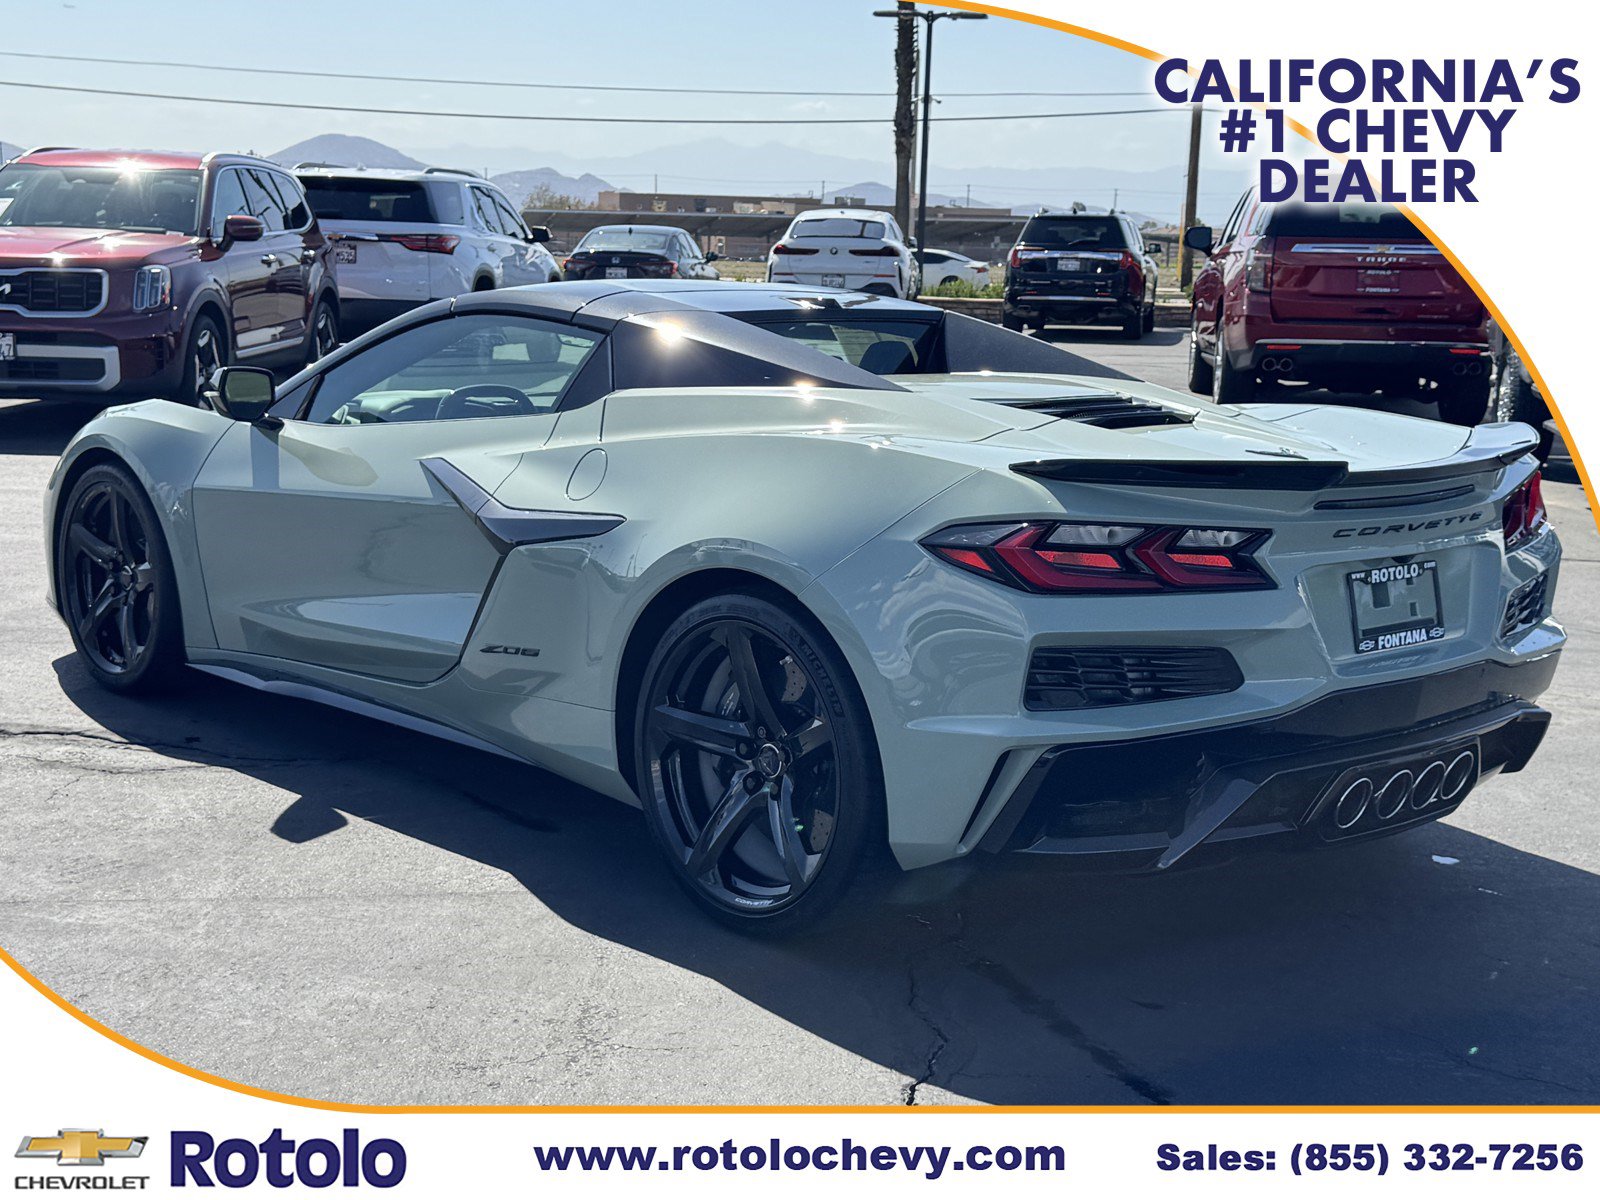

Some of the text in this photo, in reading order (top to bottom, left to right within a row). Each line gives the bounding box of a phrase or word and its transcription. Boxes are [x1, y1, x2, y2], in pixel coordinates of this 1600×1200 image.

[1333, 511, 1483, 538] CORVETTE
[1371, 563, 1420, 584] ROTOLO
[1378, 628, 1428, 649] FONTANA
[479, 644, 541, 657] Z06
